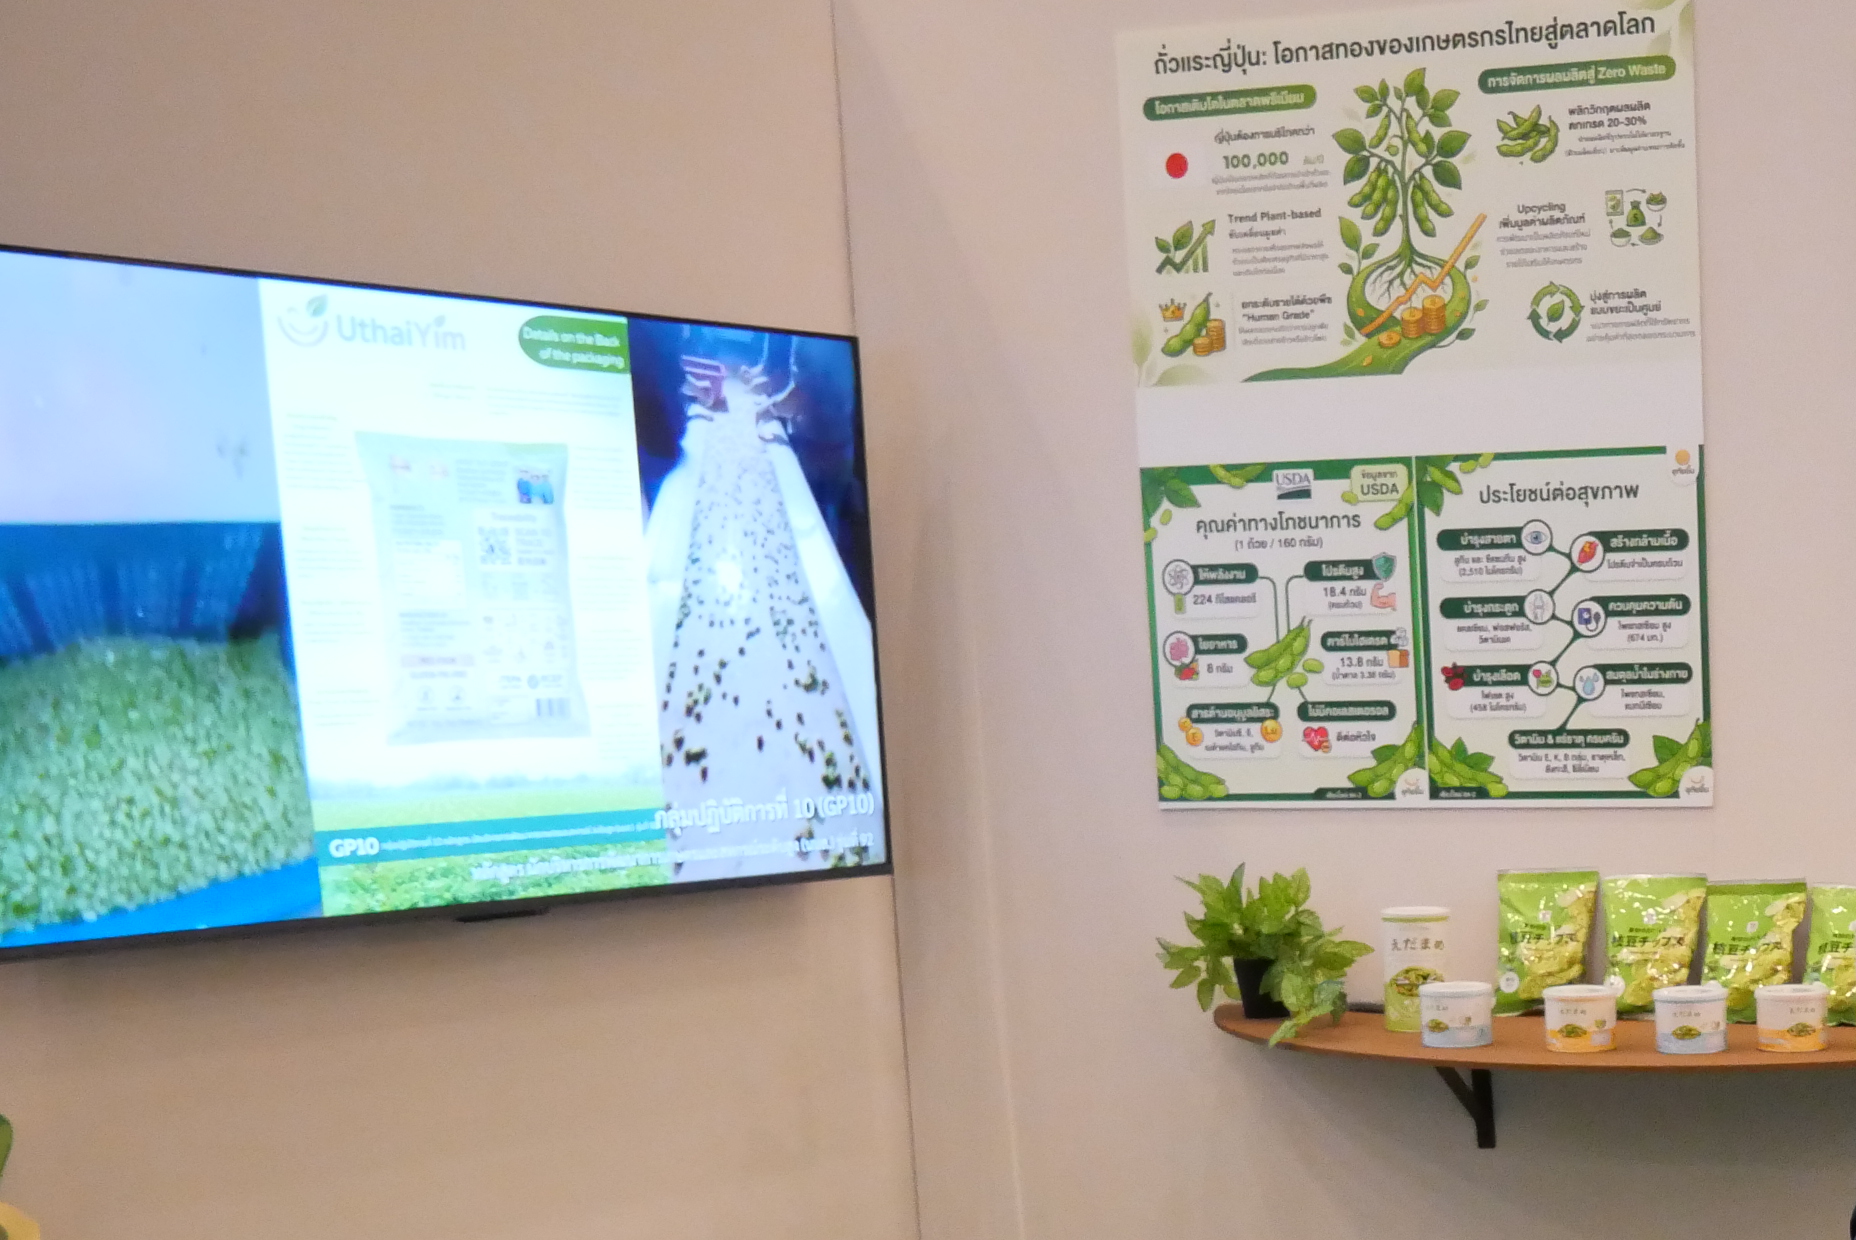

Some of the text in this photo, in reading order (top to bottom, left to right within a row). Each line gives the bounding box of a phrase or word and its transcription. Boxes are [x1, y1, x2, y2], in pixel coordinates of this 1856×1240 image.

[1153, 11, 1656, 76] ถั่วแระญี่ปุ่น: โอกาสทองของเกษตรกรไทยสู่ตลาดโลก
[1598, 67, 1626, 80] Zero
[1628, 63, 1666, 77] Waste
[1608, 116, 1647, 129] 20-30%
[1222, 151, 1289, 170] 100,000
[1228, 208, 1322, 223] Trend Plant-based
[1517, 203, 1566, 215] Upcycling
[336, 314, 467, 352] UthaiYim
[1276, 472, 1311, 486] USDA
[1361, 483, 1399, 497] USDA
[1479, 481, 1640, 508] ประโยชน์ต่อสุขภาพ
[1196, 511, 1361, 539] คุณค่าทางโภชนาการ
[1193, 594, 1213, 605] 224
[794, 796, 815, 819] 10
[818, 791, 875, 819] (GP10)
[329, 836, 380, 859] GP10
